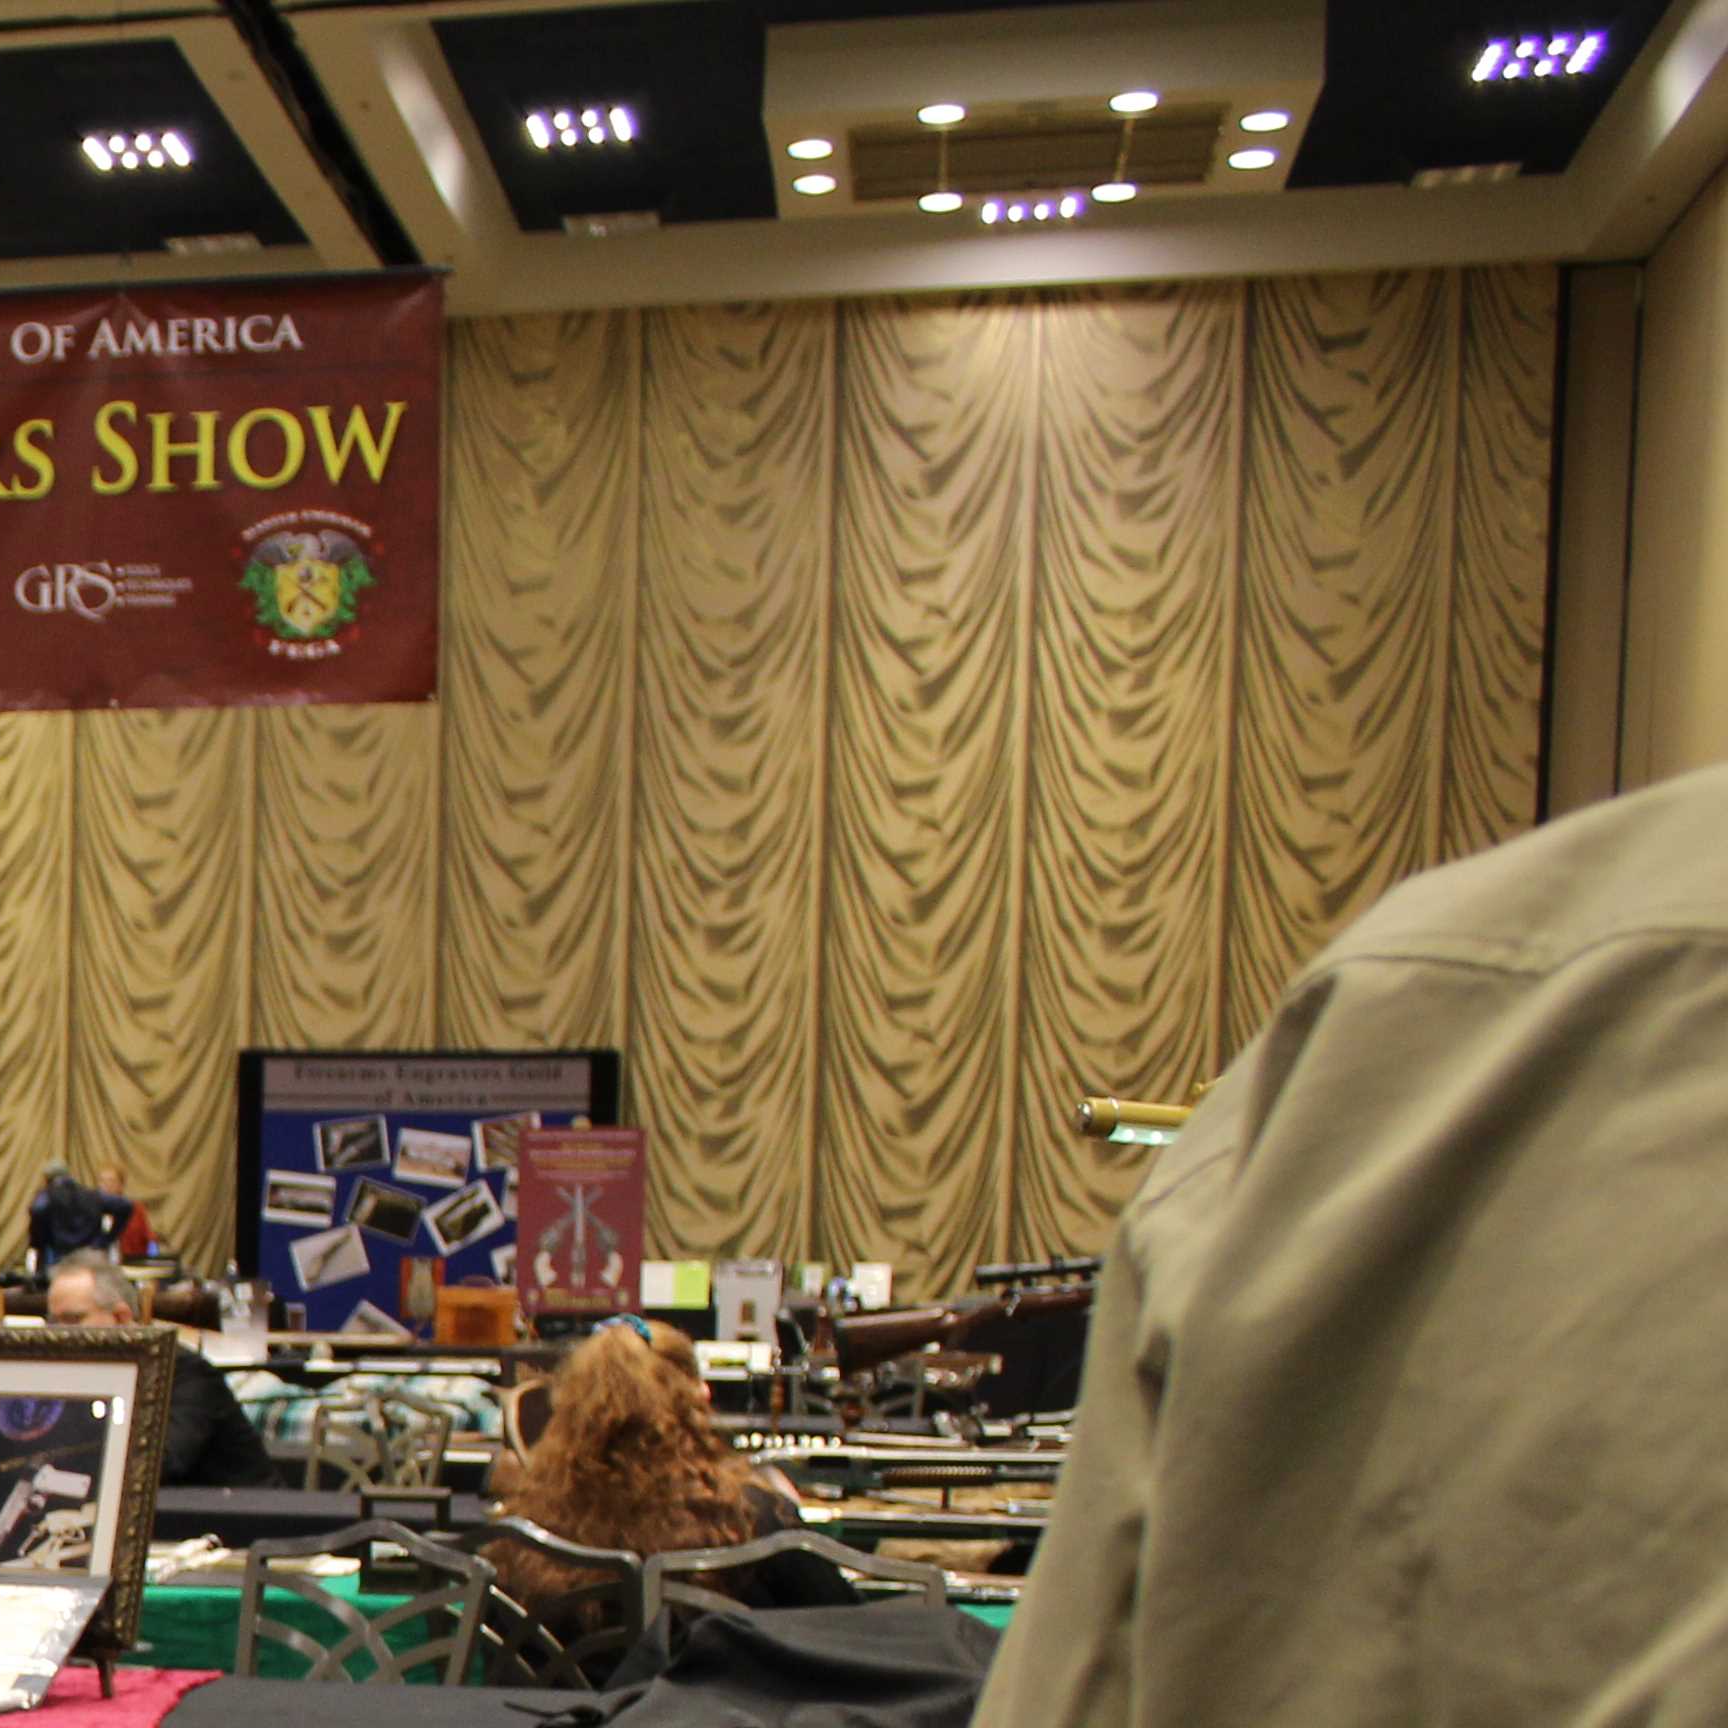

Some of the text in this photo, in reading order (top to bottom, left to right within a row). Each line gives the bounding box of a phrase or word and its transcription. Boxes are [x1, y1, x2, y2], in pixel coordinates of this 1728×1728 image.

[10, 321, 76, 362] OF
[88, 314, 303, 359] AMERICA
[91, 400, 407, 496] SHOW
[14, 560, 116, 623] GRS
